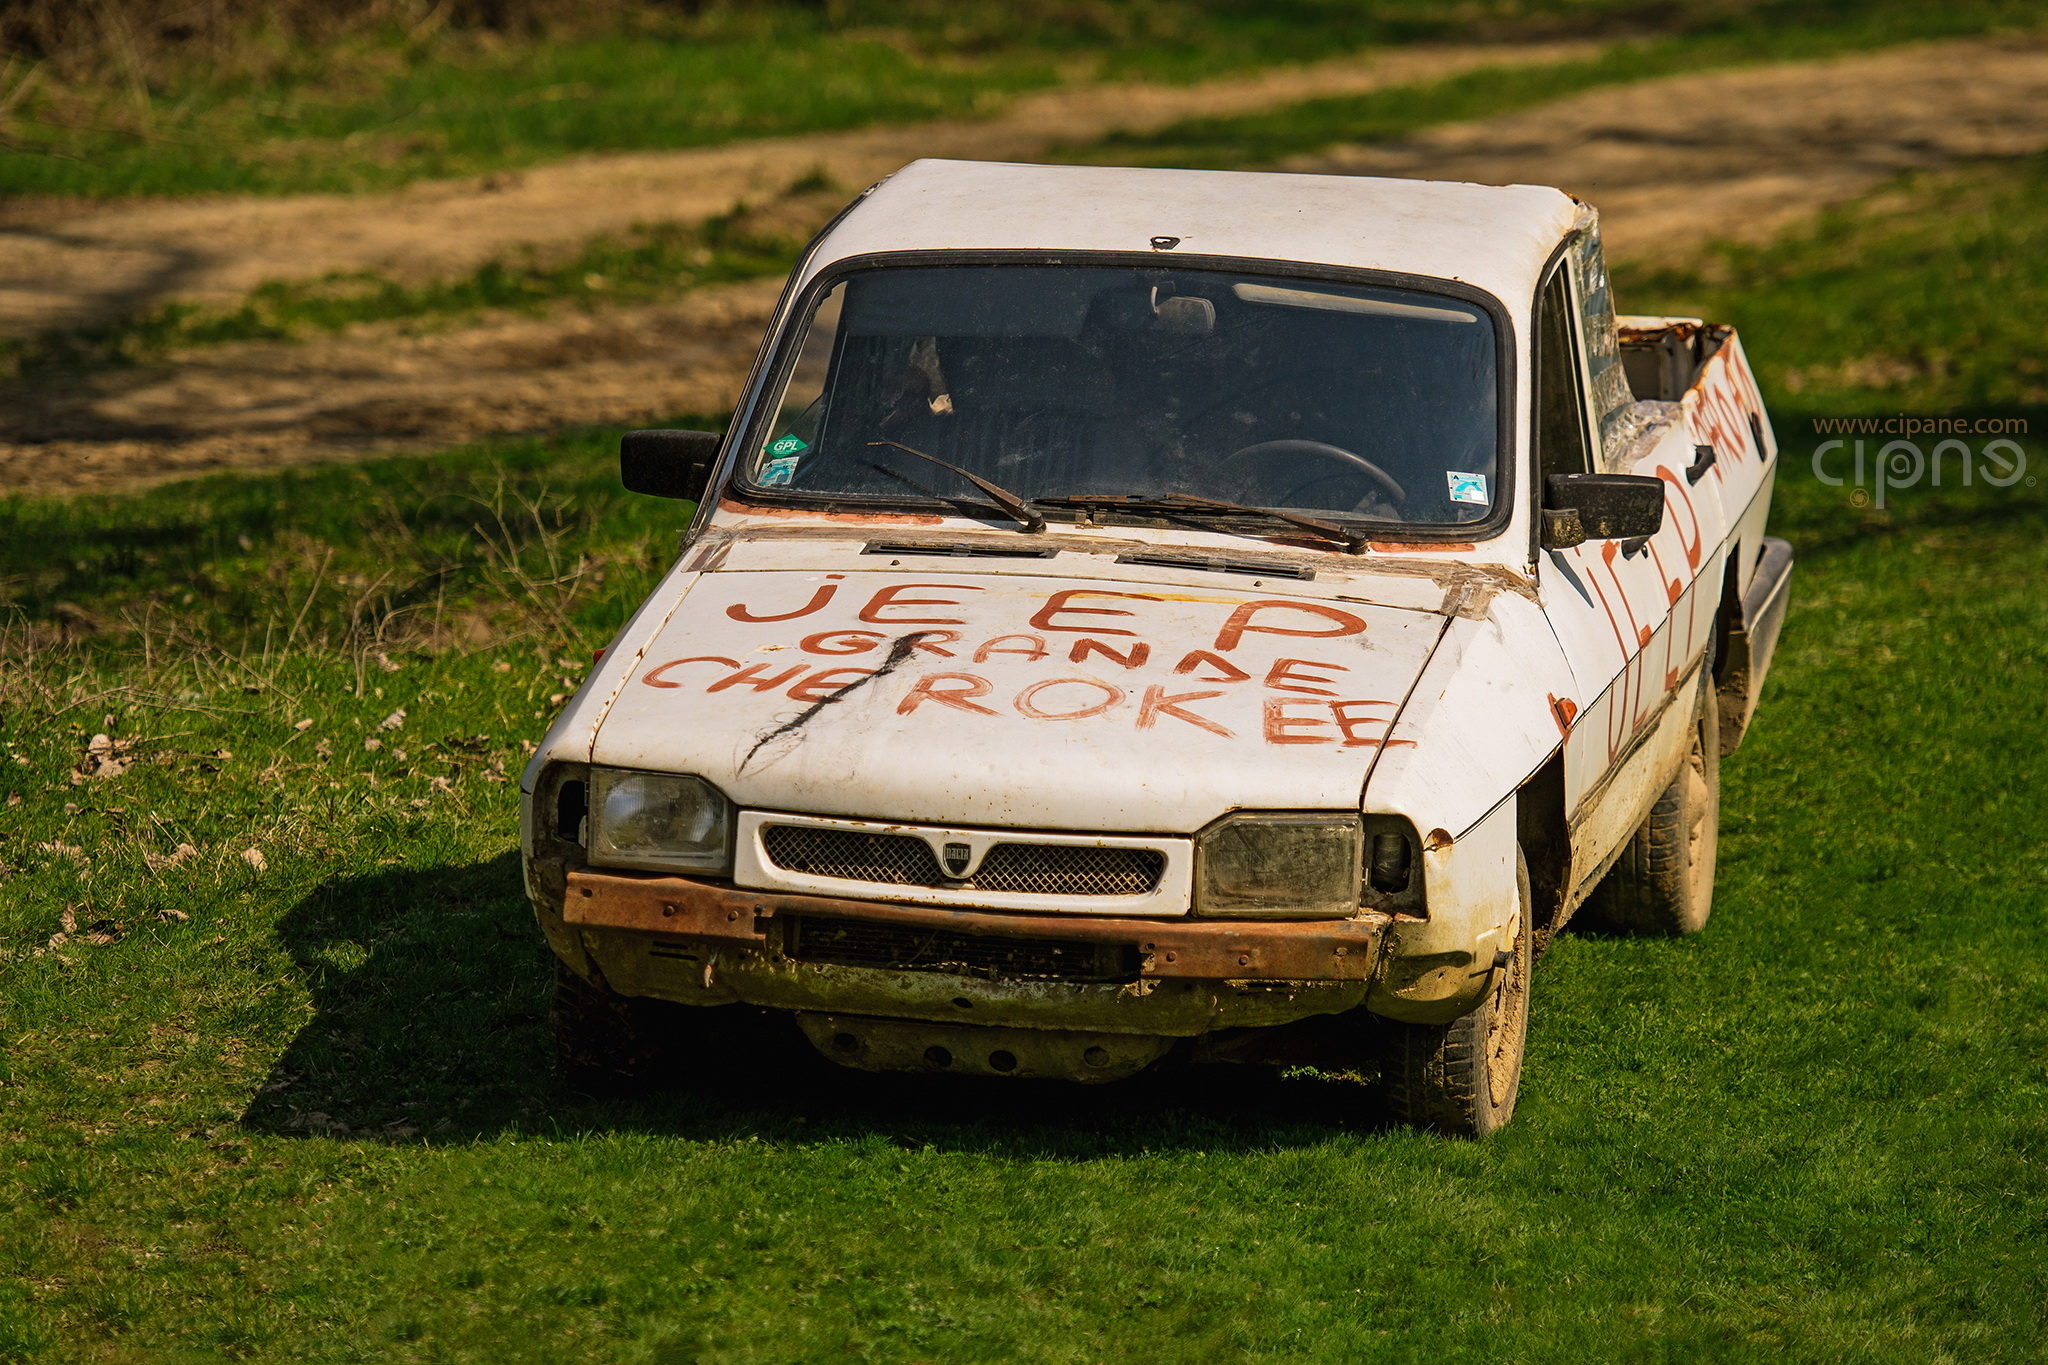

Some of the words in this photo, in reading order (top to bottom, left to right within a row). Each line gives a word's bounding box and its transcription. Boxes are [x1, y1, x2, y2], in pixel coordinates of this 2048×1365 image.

[773, 441, 797, 451] GPL
[725, 574, 1368, 652] JEEP
[799, 629, 1353, 698] GRANDE
[641, 656, 1417, 750] CHEROKEE
[946, 847, 969, 860] DACIA
